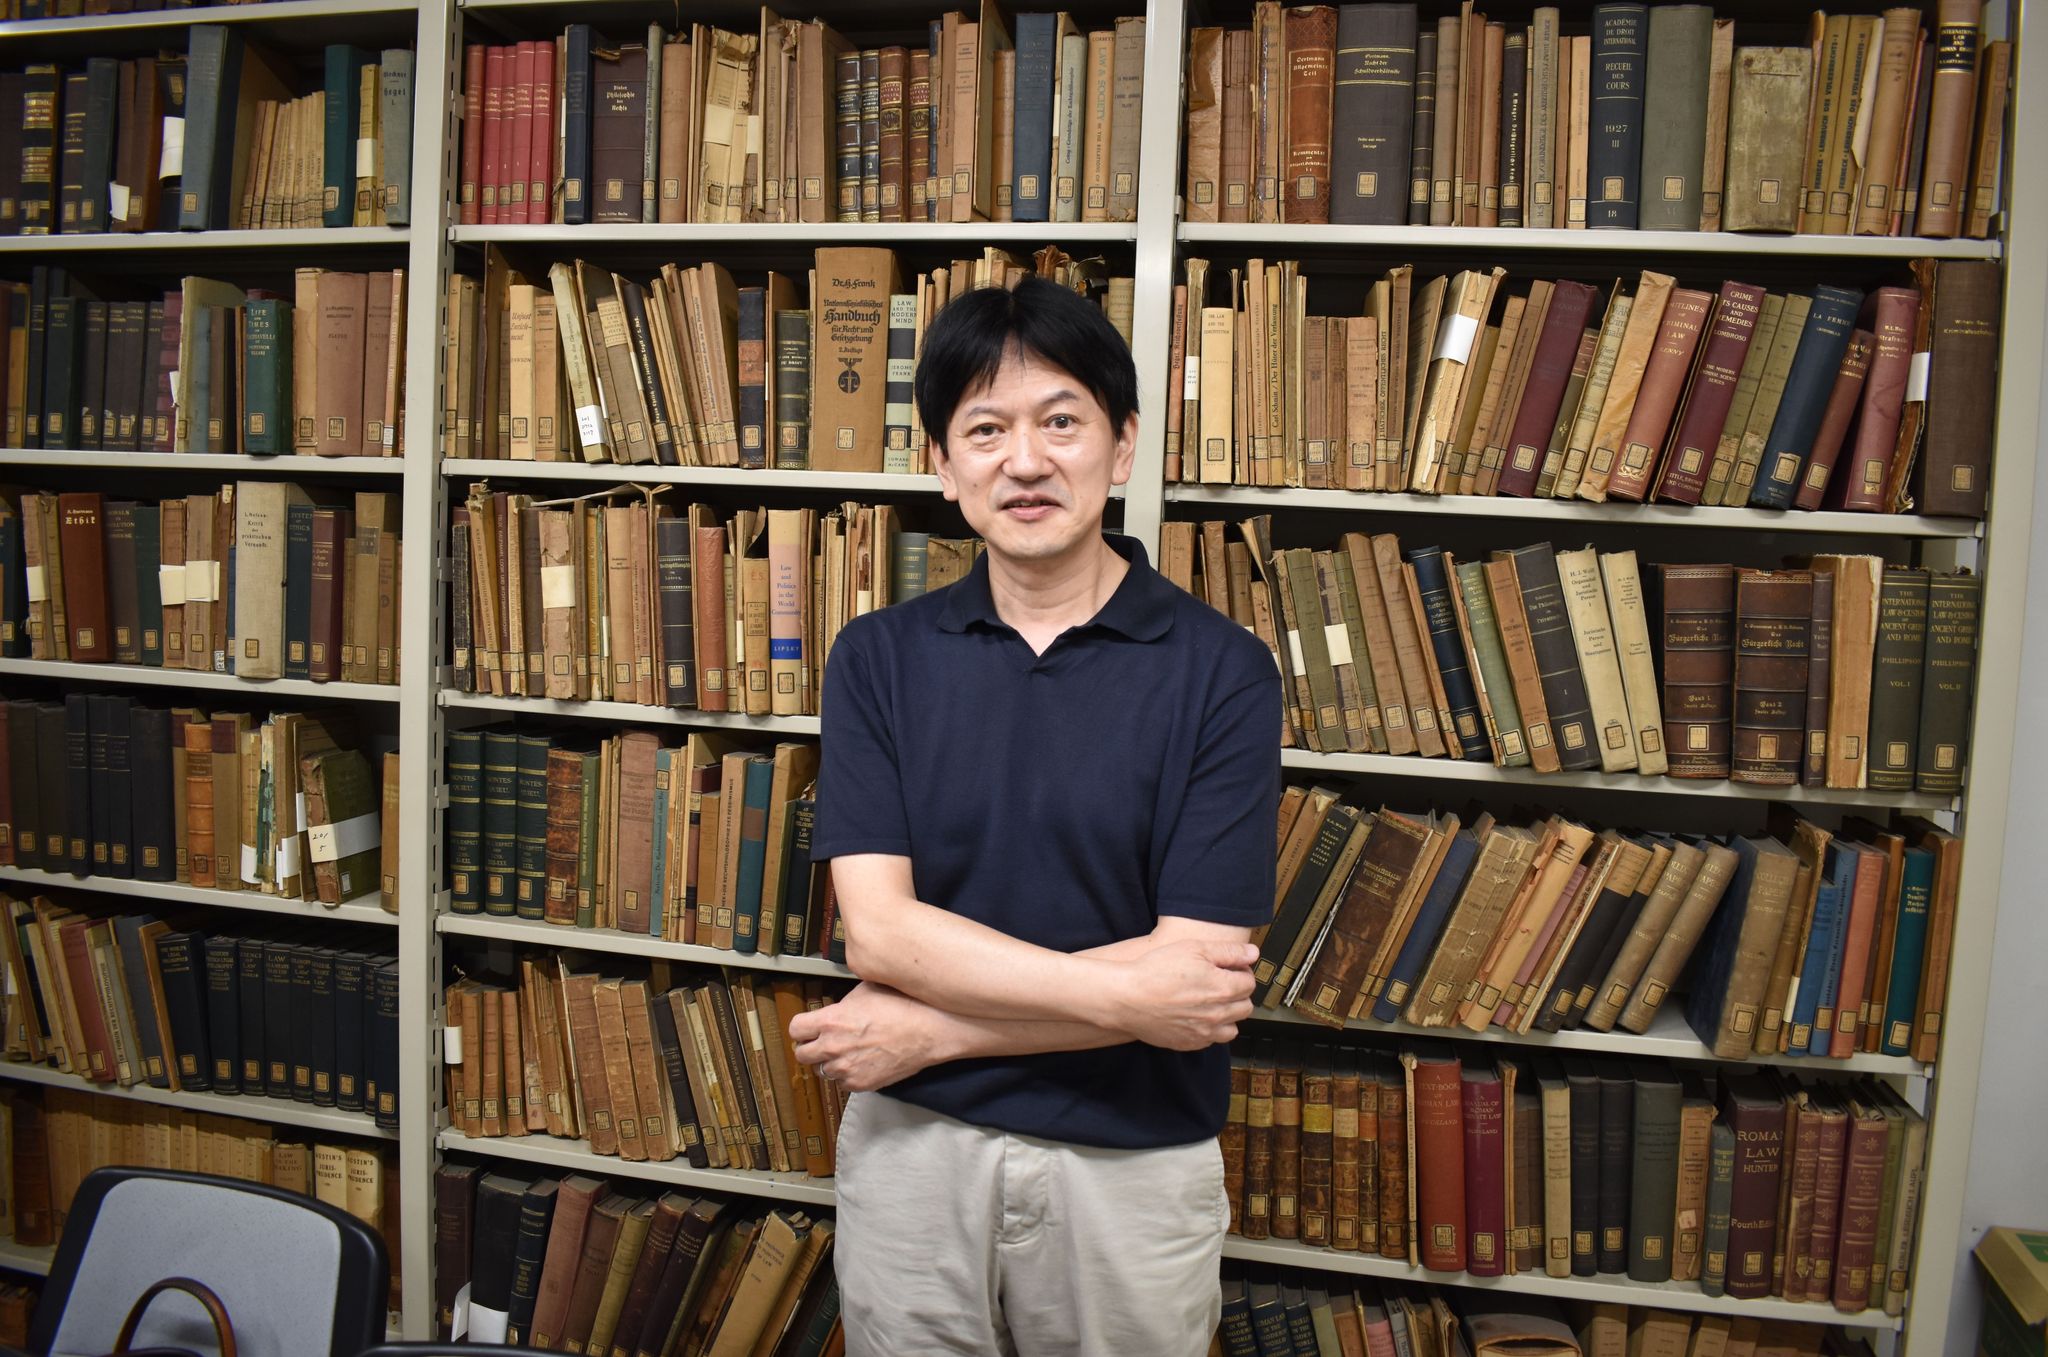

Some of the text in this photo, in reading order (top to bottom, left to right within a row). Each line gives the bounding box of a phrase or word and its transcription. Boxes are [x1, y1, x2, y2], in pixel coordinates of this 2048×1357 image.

[1605, 62, 1632, 72] RECUEIL
[1606, 81, 1630, 90] COURS
[1604, 124, 1628, 133] 1927
[1731, 290, 1753, 302] CRIME
[1732, 301, 1758, 314] CAUSES
[823, 308, 881, 326] Handbuch
[1738, 1130, 1782, 1142] ROMA
[1746, 1147, 1779, 1158] LAW
[1743, 1164, 1778, 1173] HUNTER
